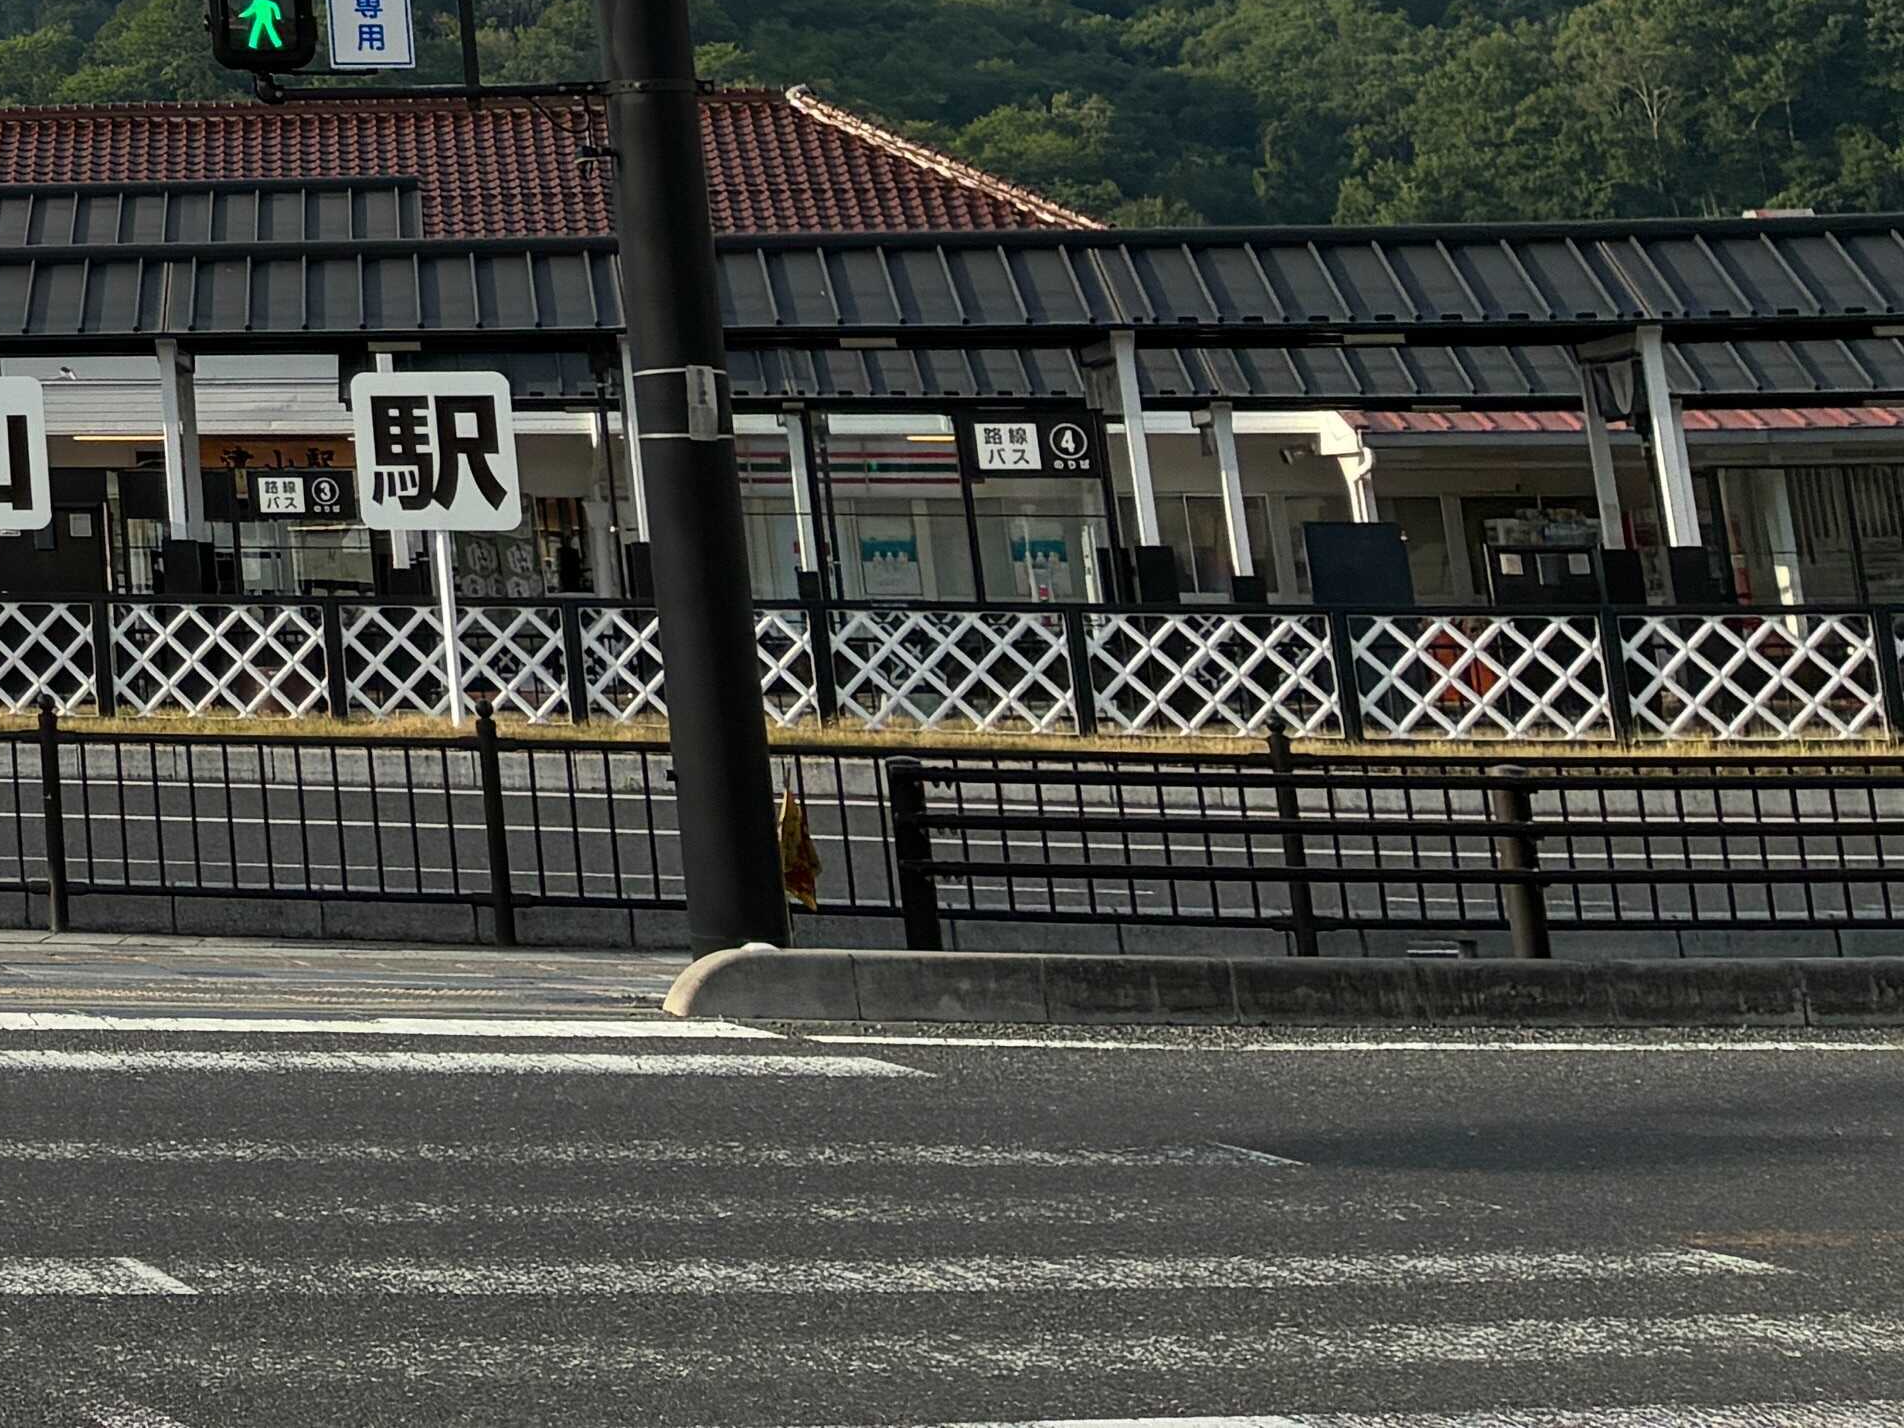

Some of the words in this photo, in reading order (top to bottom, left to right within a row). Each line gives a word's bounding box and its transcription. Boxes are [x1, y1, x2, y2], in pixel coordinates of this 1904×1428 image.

[984, 427, 1028, 445] 路線
[370, 395, 508, 512] 駅
[989, 448, 1030, 464] バス
[264, 480, 297, 494] 路線
[267, 497, 297, 509] バス
